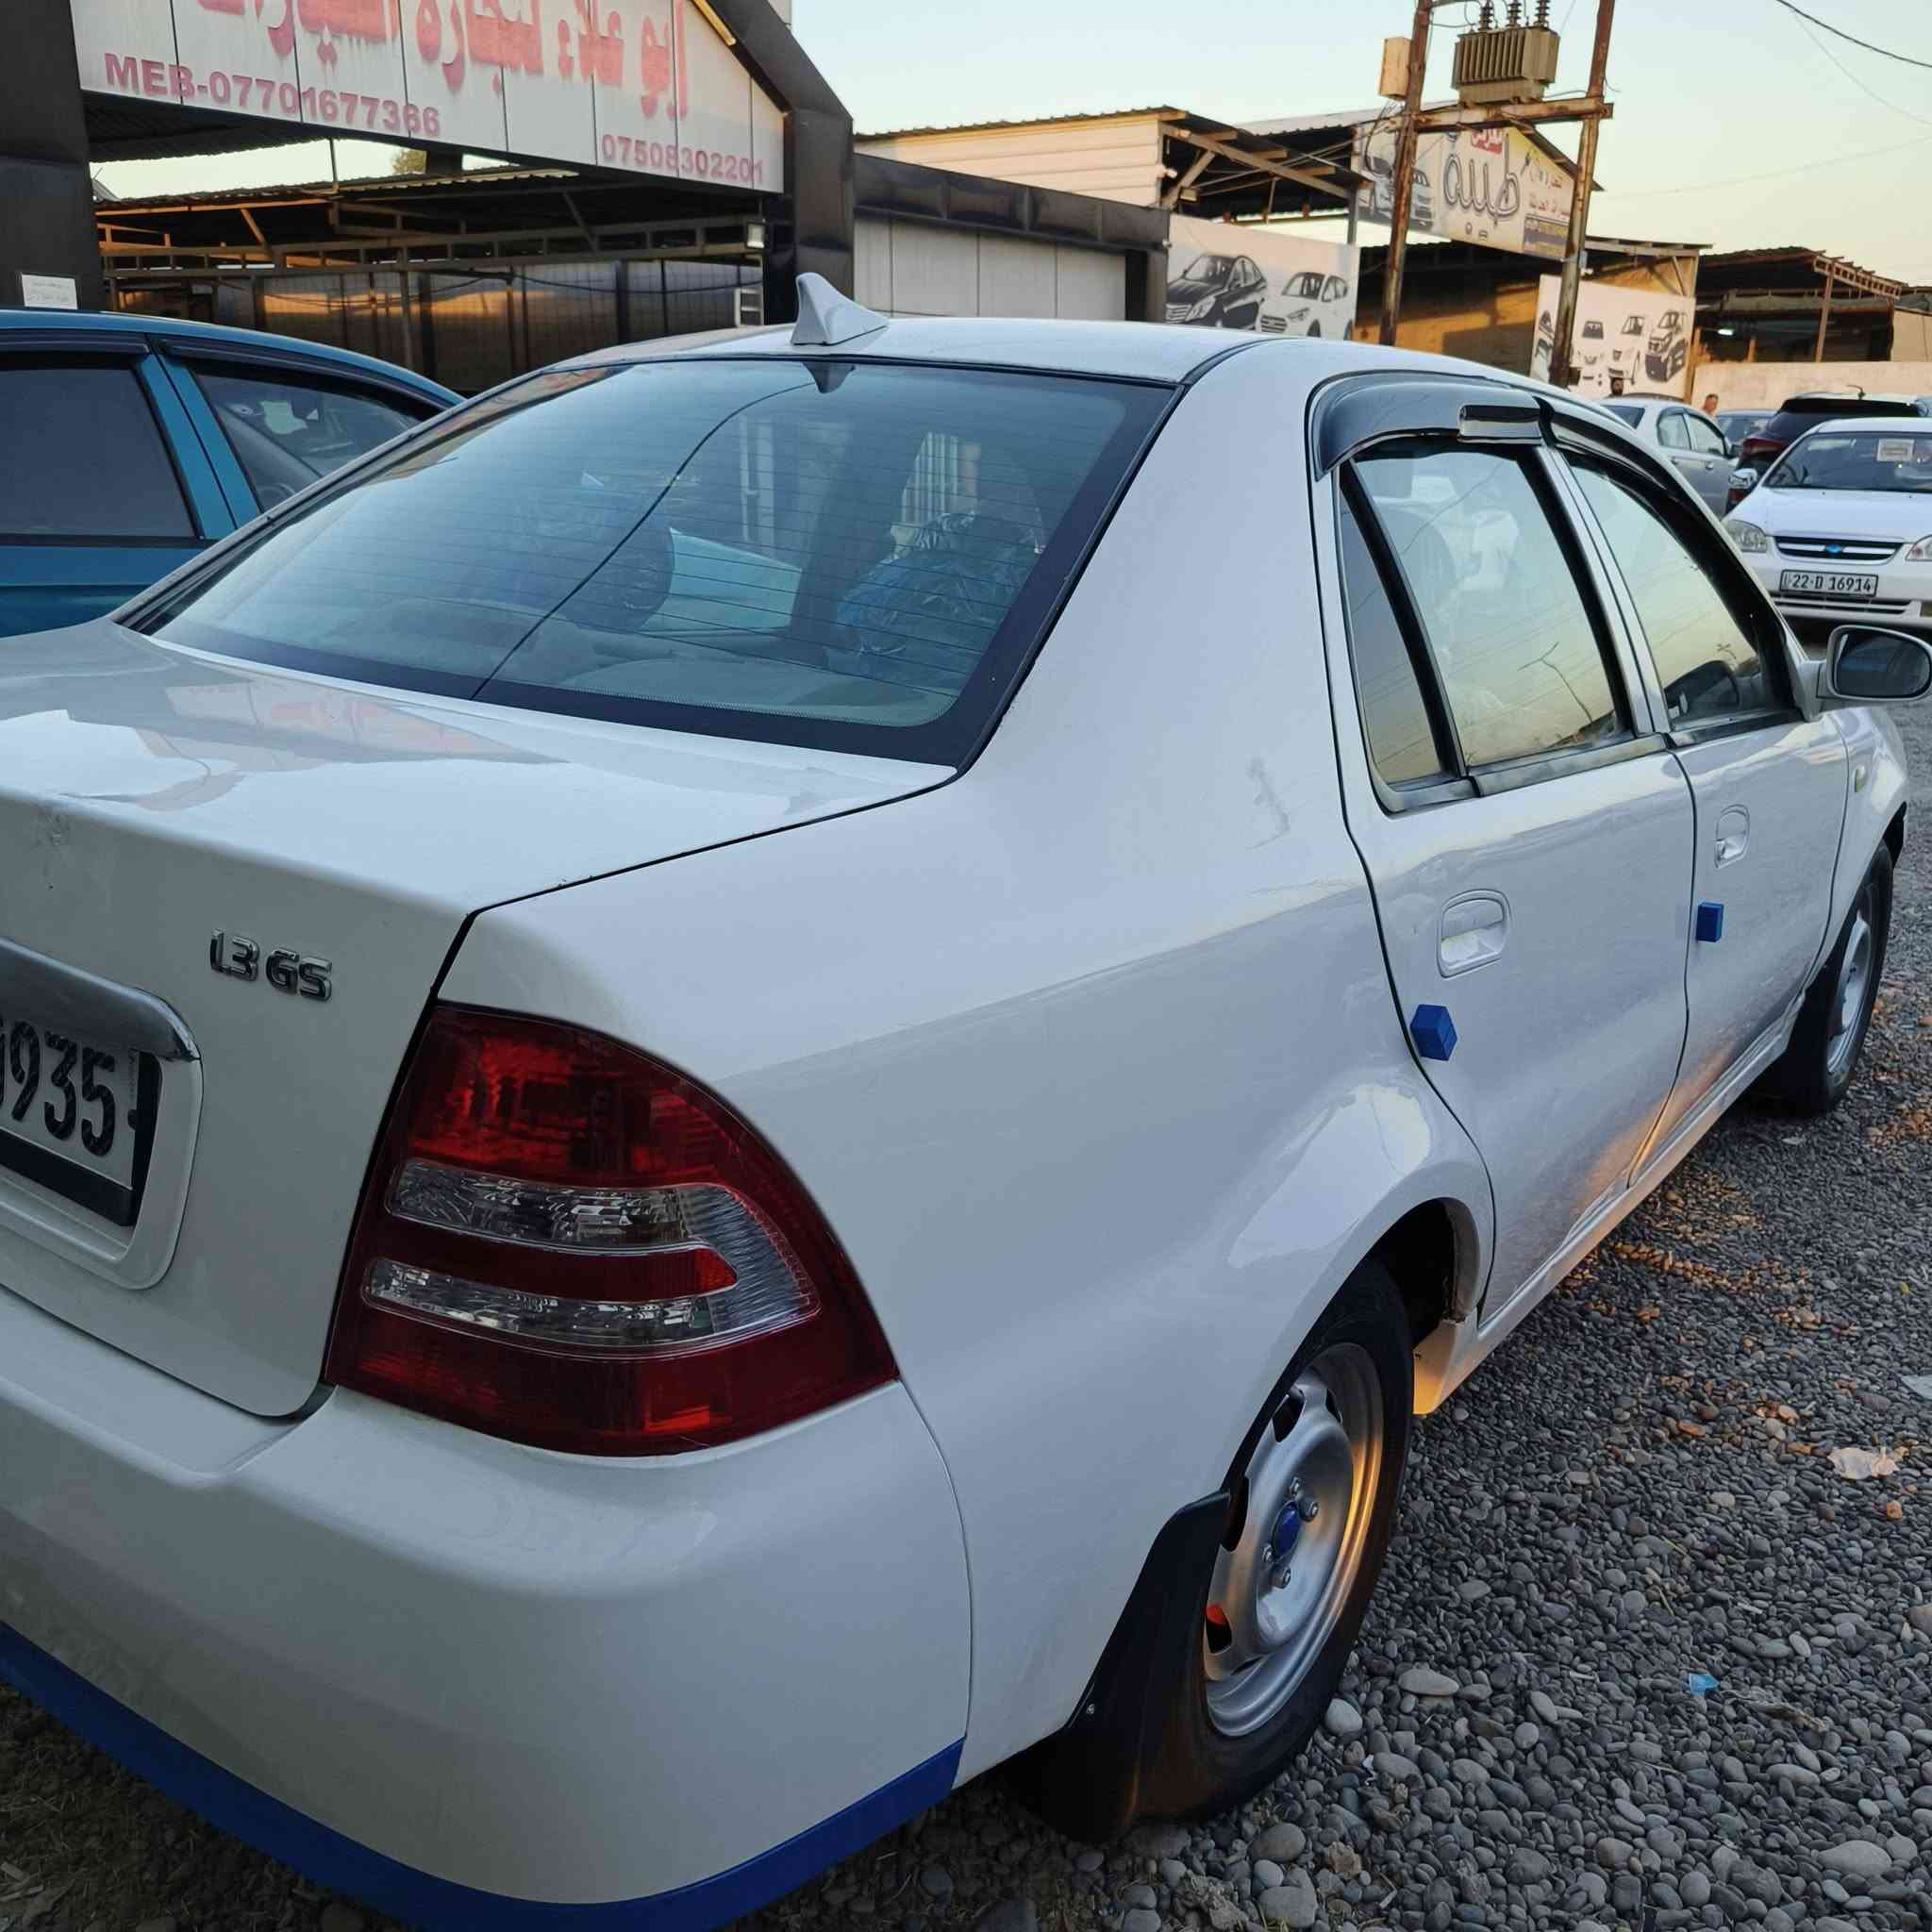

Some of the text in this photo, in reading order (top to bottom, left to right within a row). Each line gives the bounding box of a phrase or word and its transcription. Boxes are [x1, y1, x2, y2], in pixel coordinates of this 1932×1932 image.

[1828, 576, 1872, 592] 16914
[265, 946, 333, 1003] GS
[0, 1015, 116, 1157] 935
